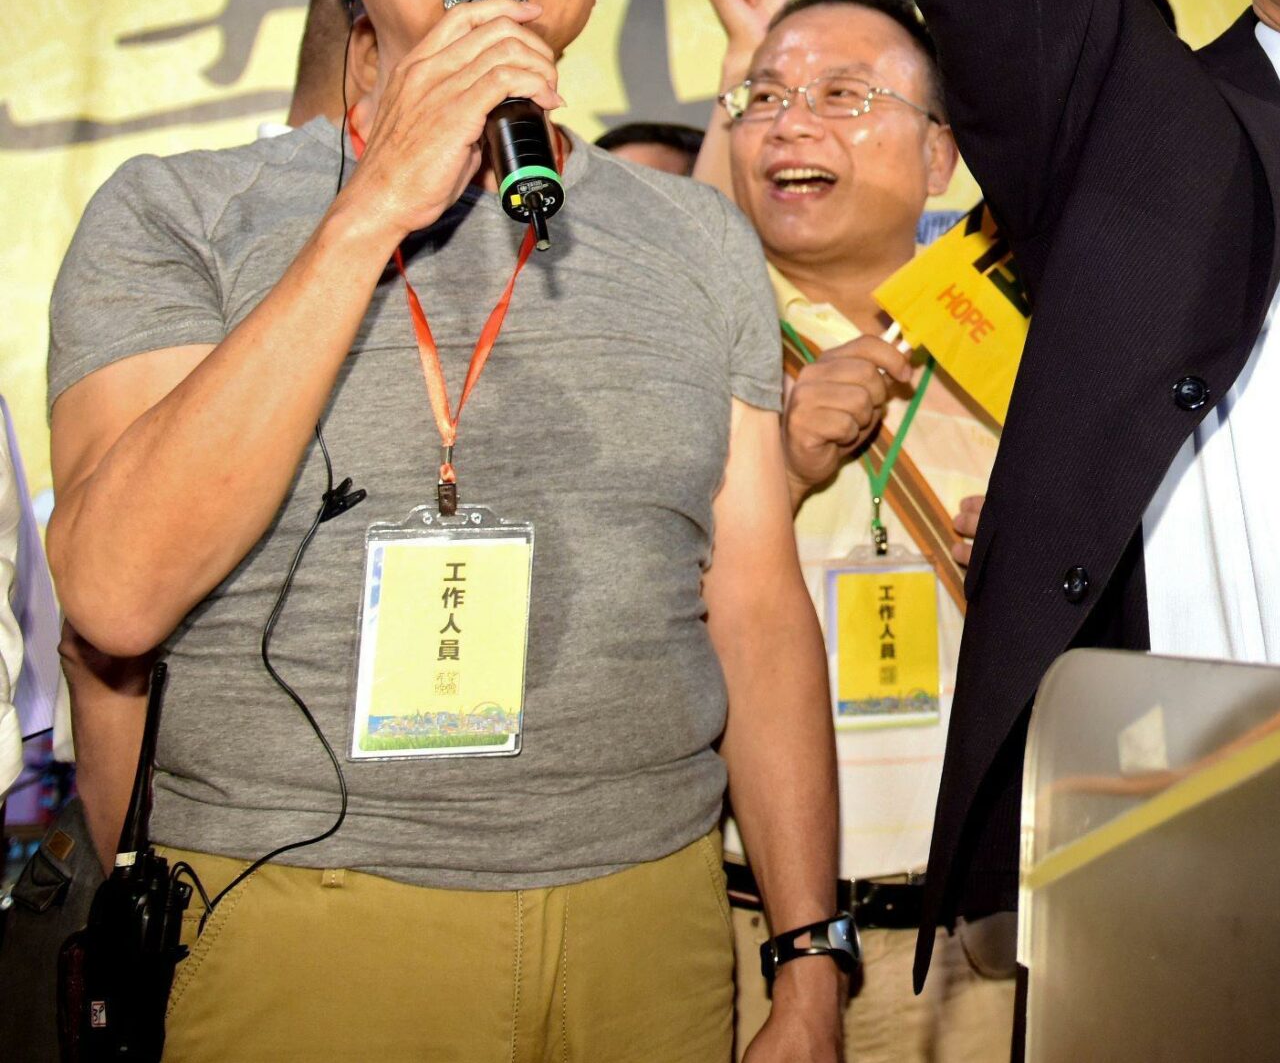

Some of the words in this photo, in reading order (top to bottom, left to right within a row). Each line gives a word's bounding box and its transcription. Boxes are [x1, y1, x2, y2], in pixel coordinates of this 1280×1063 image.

[936, 282, 996, 345] HOPE
[436, 562, 467, 662] 工作人員
[878, 584, 897, 661] 工作人員
